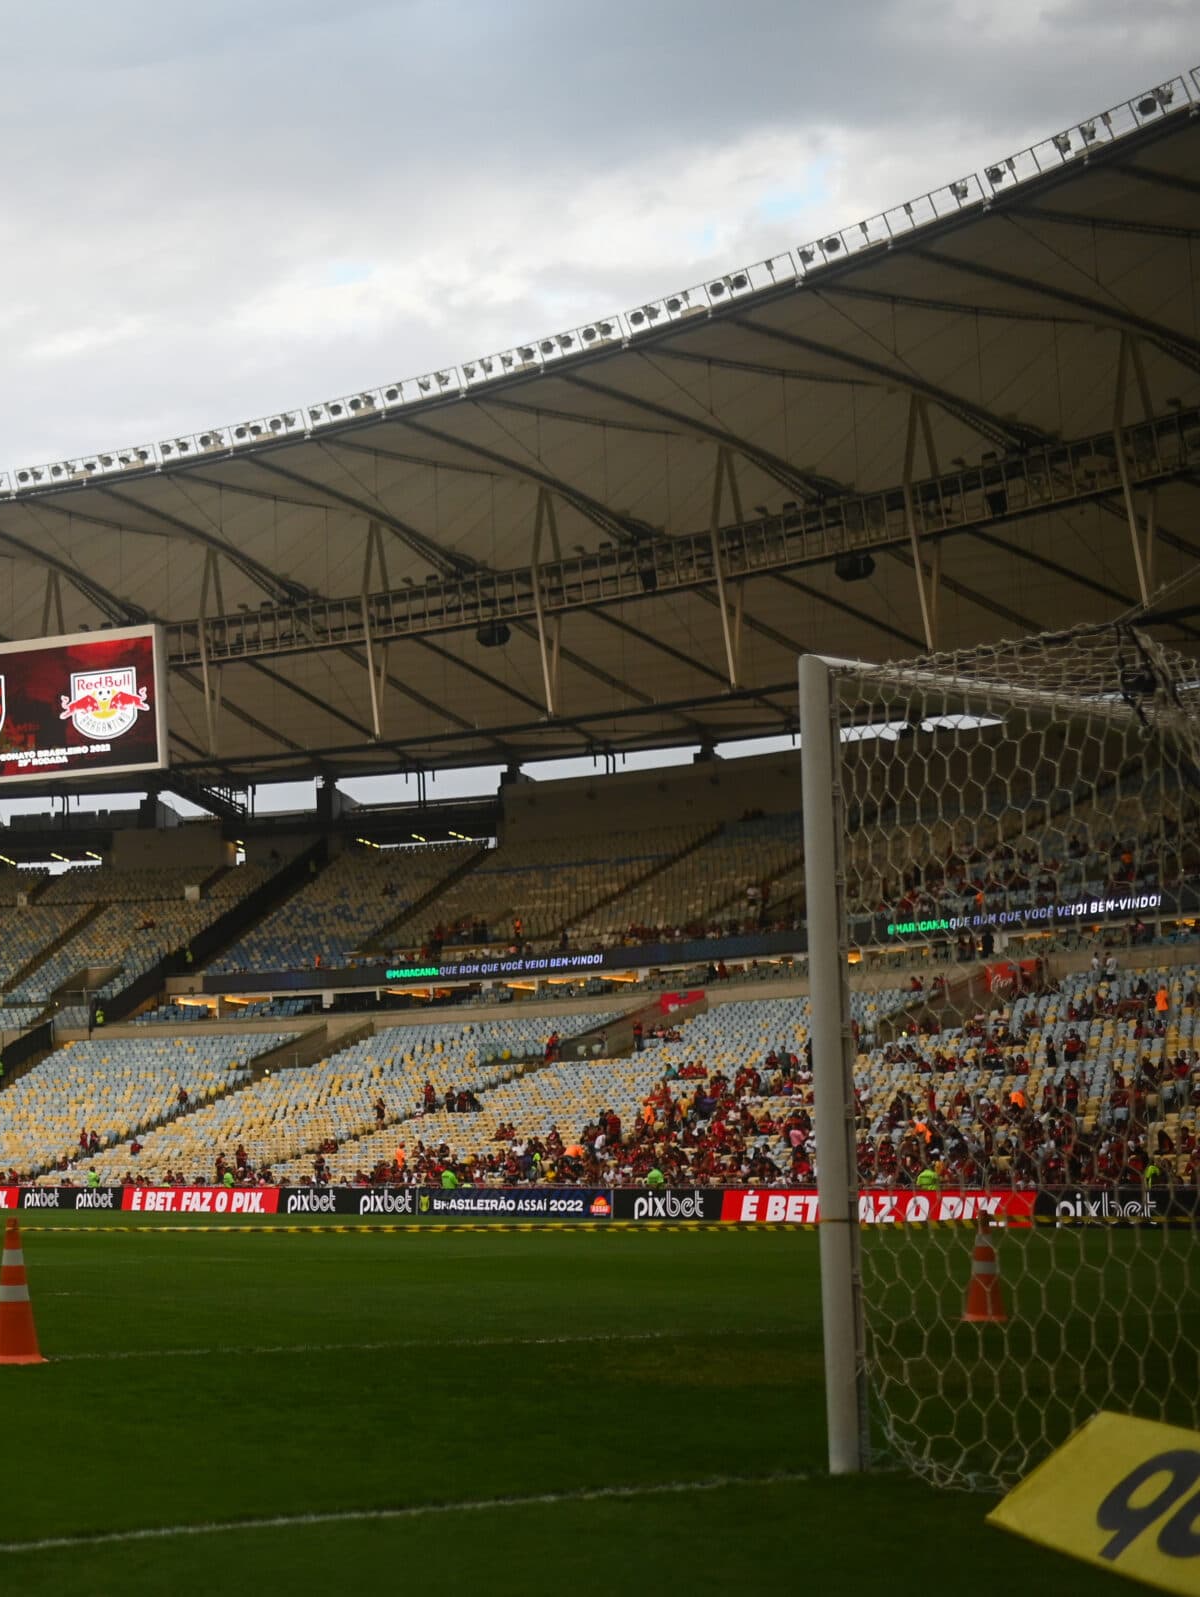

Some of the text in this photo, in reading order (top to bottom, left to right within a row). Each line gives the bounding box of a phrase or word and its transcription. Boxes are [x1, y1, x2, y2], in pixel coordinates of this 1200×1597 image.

[77, 673, 130, 691] Red Bull
[949, 917, 971, 930] QUE
[999, 911, 1022, 925] QUE
[1090, 895, 1162, 914] BEM-VINDO!
[439, 966, 457, 976] QUE
[460, 964, 480, 975] BOM
[481, 963, 499, 974] QUE
[550, 954, 603, 968] BEM-VINDO!
[24, 1188, 59, 1209] pixbet
[76, 1188, 113, 1210] pixbet
[131, 1188, 265, 1213] É BET. FAZ O PIX.
[287, 1189, 336, 1214] pixbet
[360, 1189, 412, 1215] pixbet
[434, 1196, 583, 1212] BRASILEIRÃO ASSAÍ 2022
[634, 1190, 704, 1220] pixbet
[740, 1190, 760, 1222] É
[858, 1196, 898, 1223] AZ
[905, 1196, 930, 1222] O
[1056, 1191, 1157, 1228] pixbet
